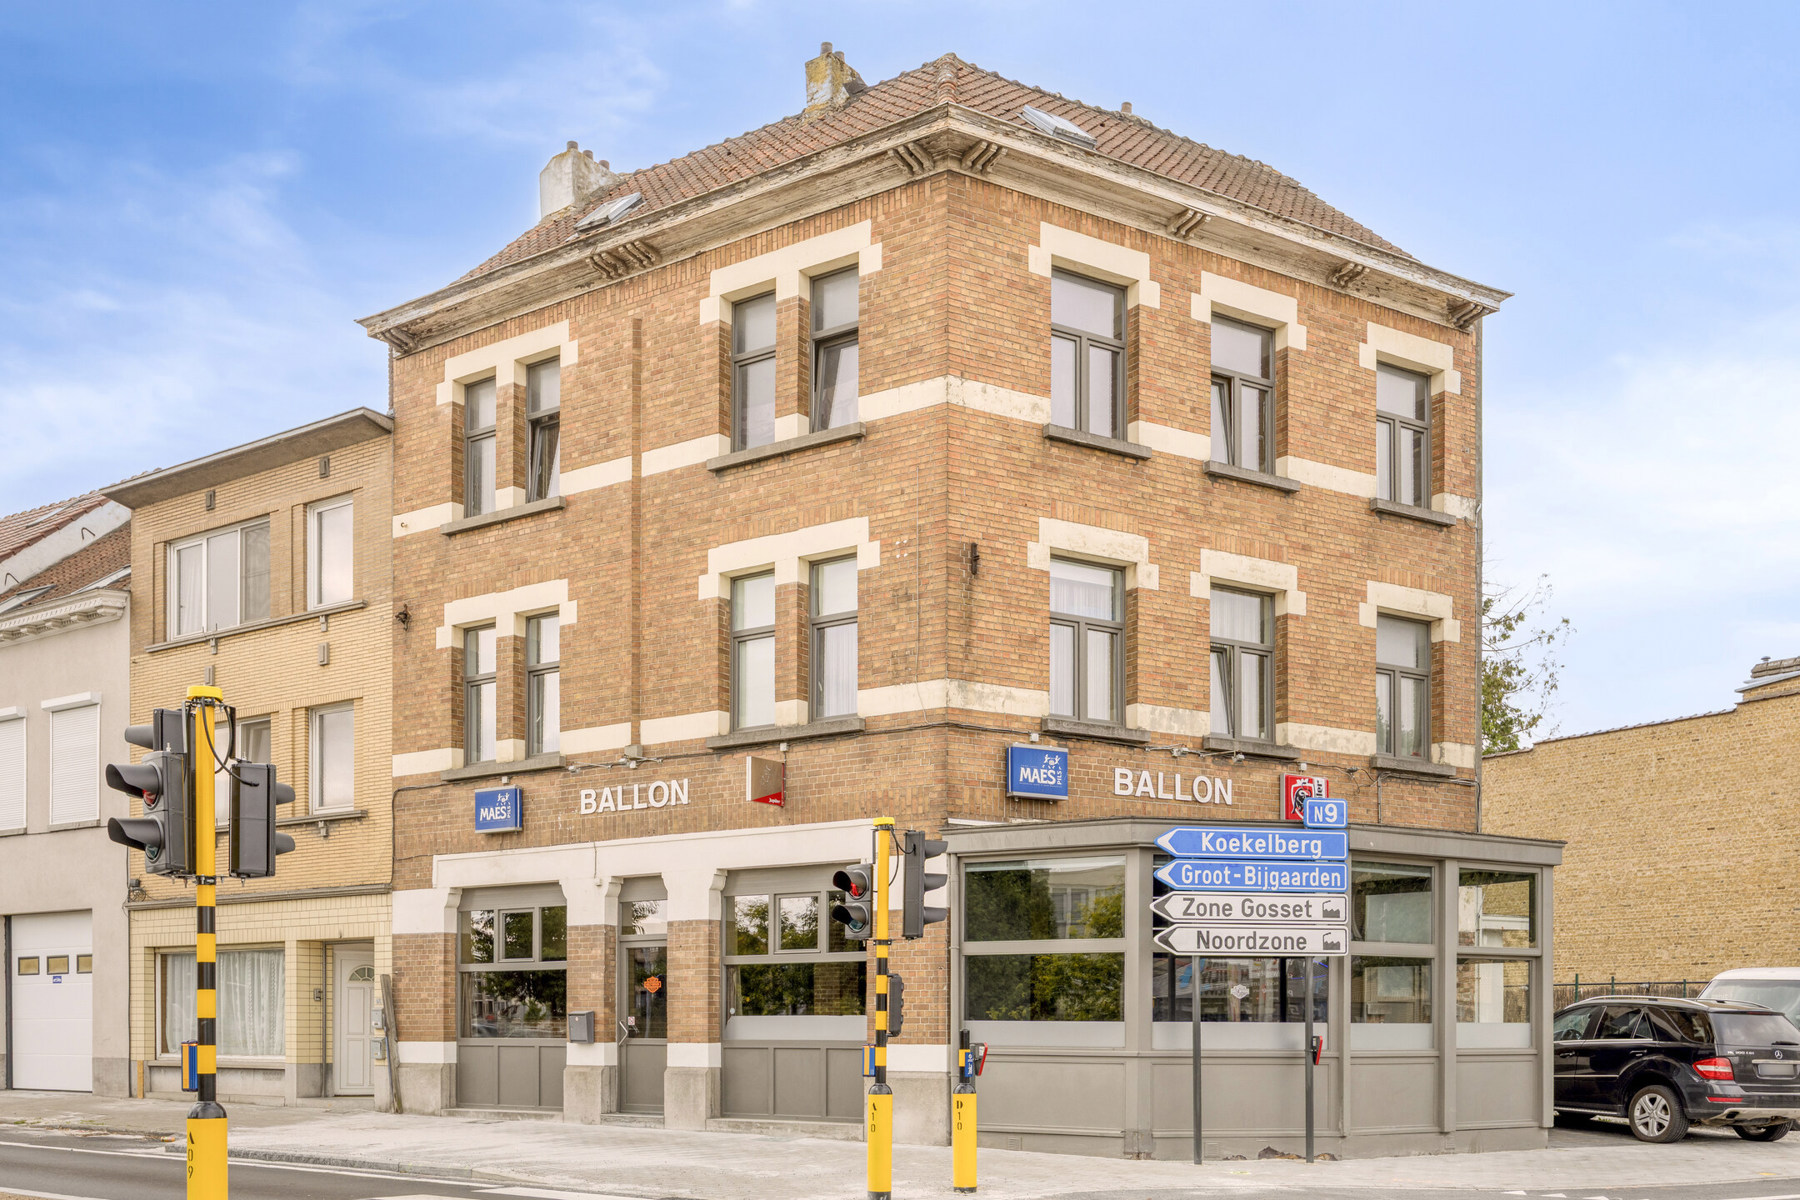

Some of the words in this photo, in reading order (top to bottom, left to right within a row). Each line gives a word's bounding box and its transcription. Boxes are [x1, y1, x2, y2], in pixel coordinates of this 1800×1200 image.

[1019, 766, 1056, 785] MAES
[580, 778, 689, 815] BALLON
[1114, 767, 1233, 806] BALLON
[479, 806, 507, 821] MAES
[1314, 803, 1338, 823] N9
[1201, 832, 1322, 859] Koekelberg
[1181, 864, 1341, 891] Groot-Bijgaarden
[1182, 897, 1233, 917] Zone
[1241, 898, 1313, 918] Gosset
[1196, 930, 1307, 950] Noordzone
